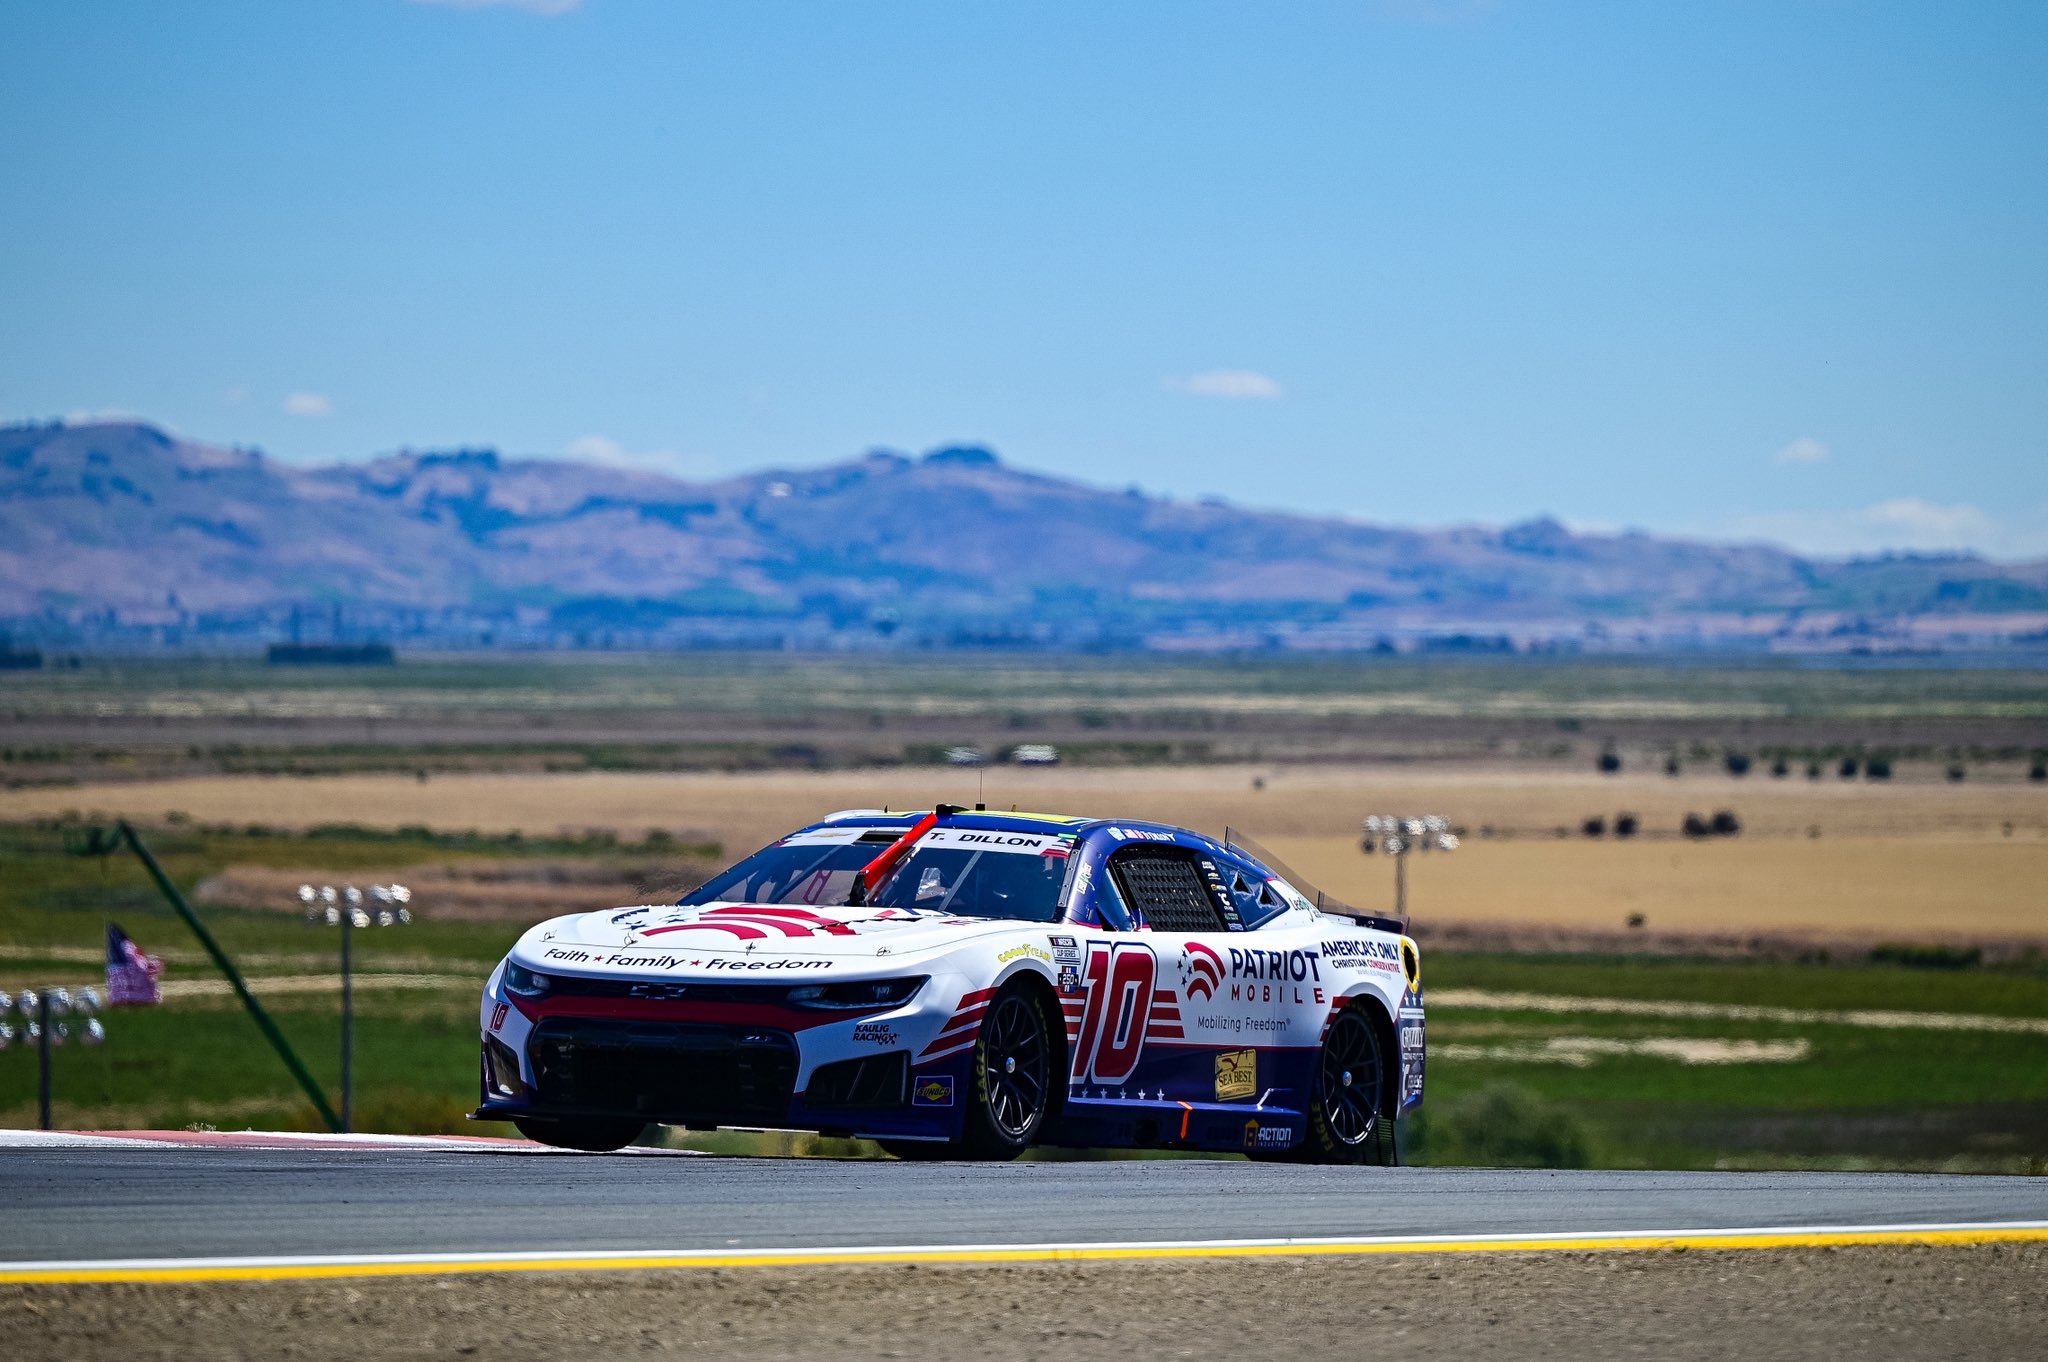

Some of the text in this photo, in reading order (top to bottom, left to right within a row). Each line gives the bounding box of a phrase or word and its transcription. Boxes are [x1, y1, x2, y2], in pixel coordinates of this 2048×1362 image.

[930, 832, 1042, 848] T. DILLON
[1056, 949, 1076, 958] CUP SERIES
[1321, 940, 1400, 960] AMERICA'S ONLY
[544, 948, 834, 970] Faith Family Freedom
[1228, 947, 1320, 982] PATRIOT
[1332, 959, 1401, 973] CHRISTIAN CONSERVATIVE
[1062, 974, 1075, 985] 250
[1231, 984, 1326, 1005] MOBILE
[490, 1000, 512, 1033] 10
[1069, 941, 1157, 1085] 10
[855, 1024, 890, 1033] KAULIG
[1197, 1015, 1241, 1032] Mobilizing
[853, 1033, 889, 1042] RACING
[976, 1039, 988, 1102] EAGLE
[1218, 1070, 1253, 1088] SEA BEST
[916, 1087, 951, 1096] SUNOCO
[1258, 1127, 1292, 1141] ACTION
